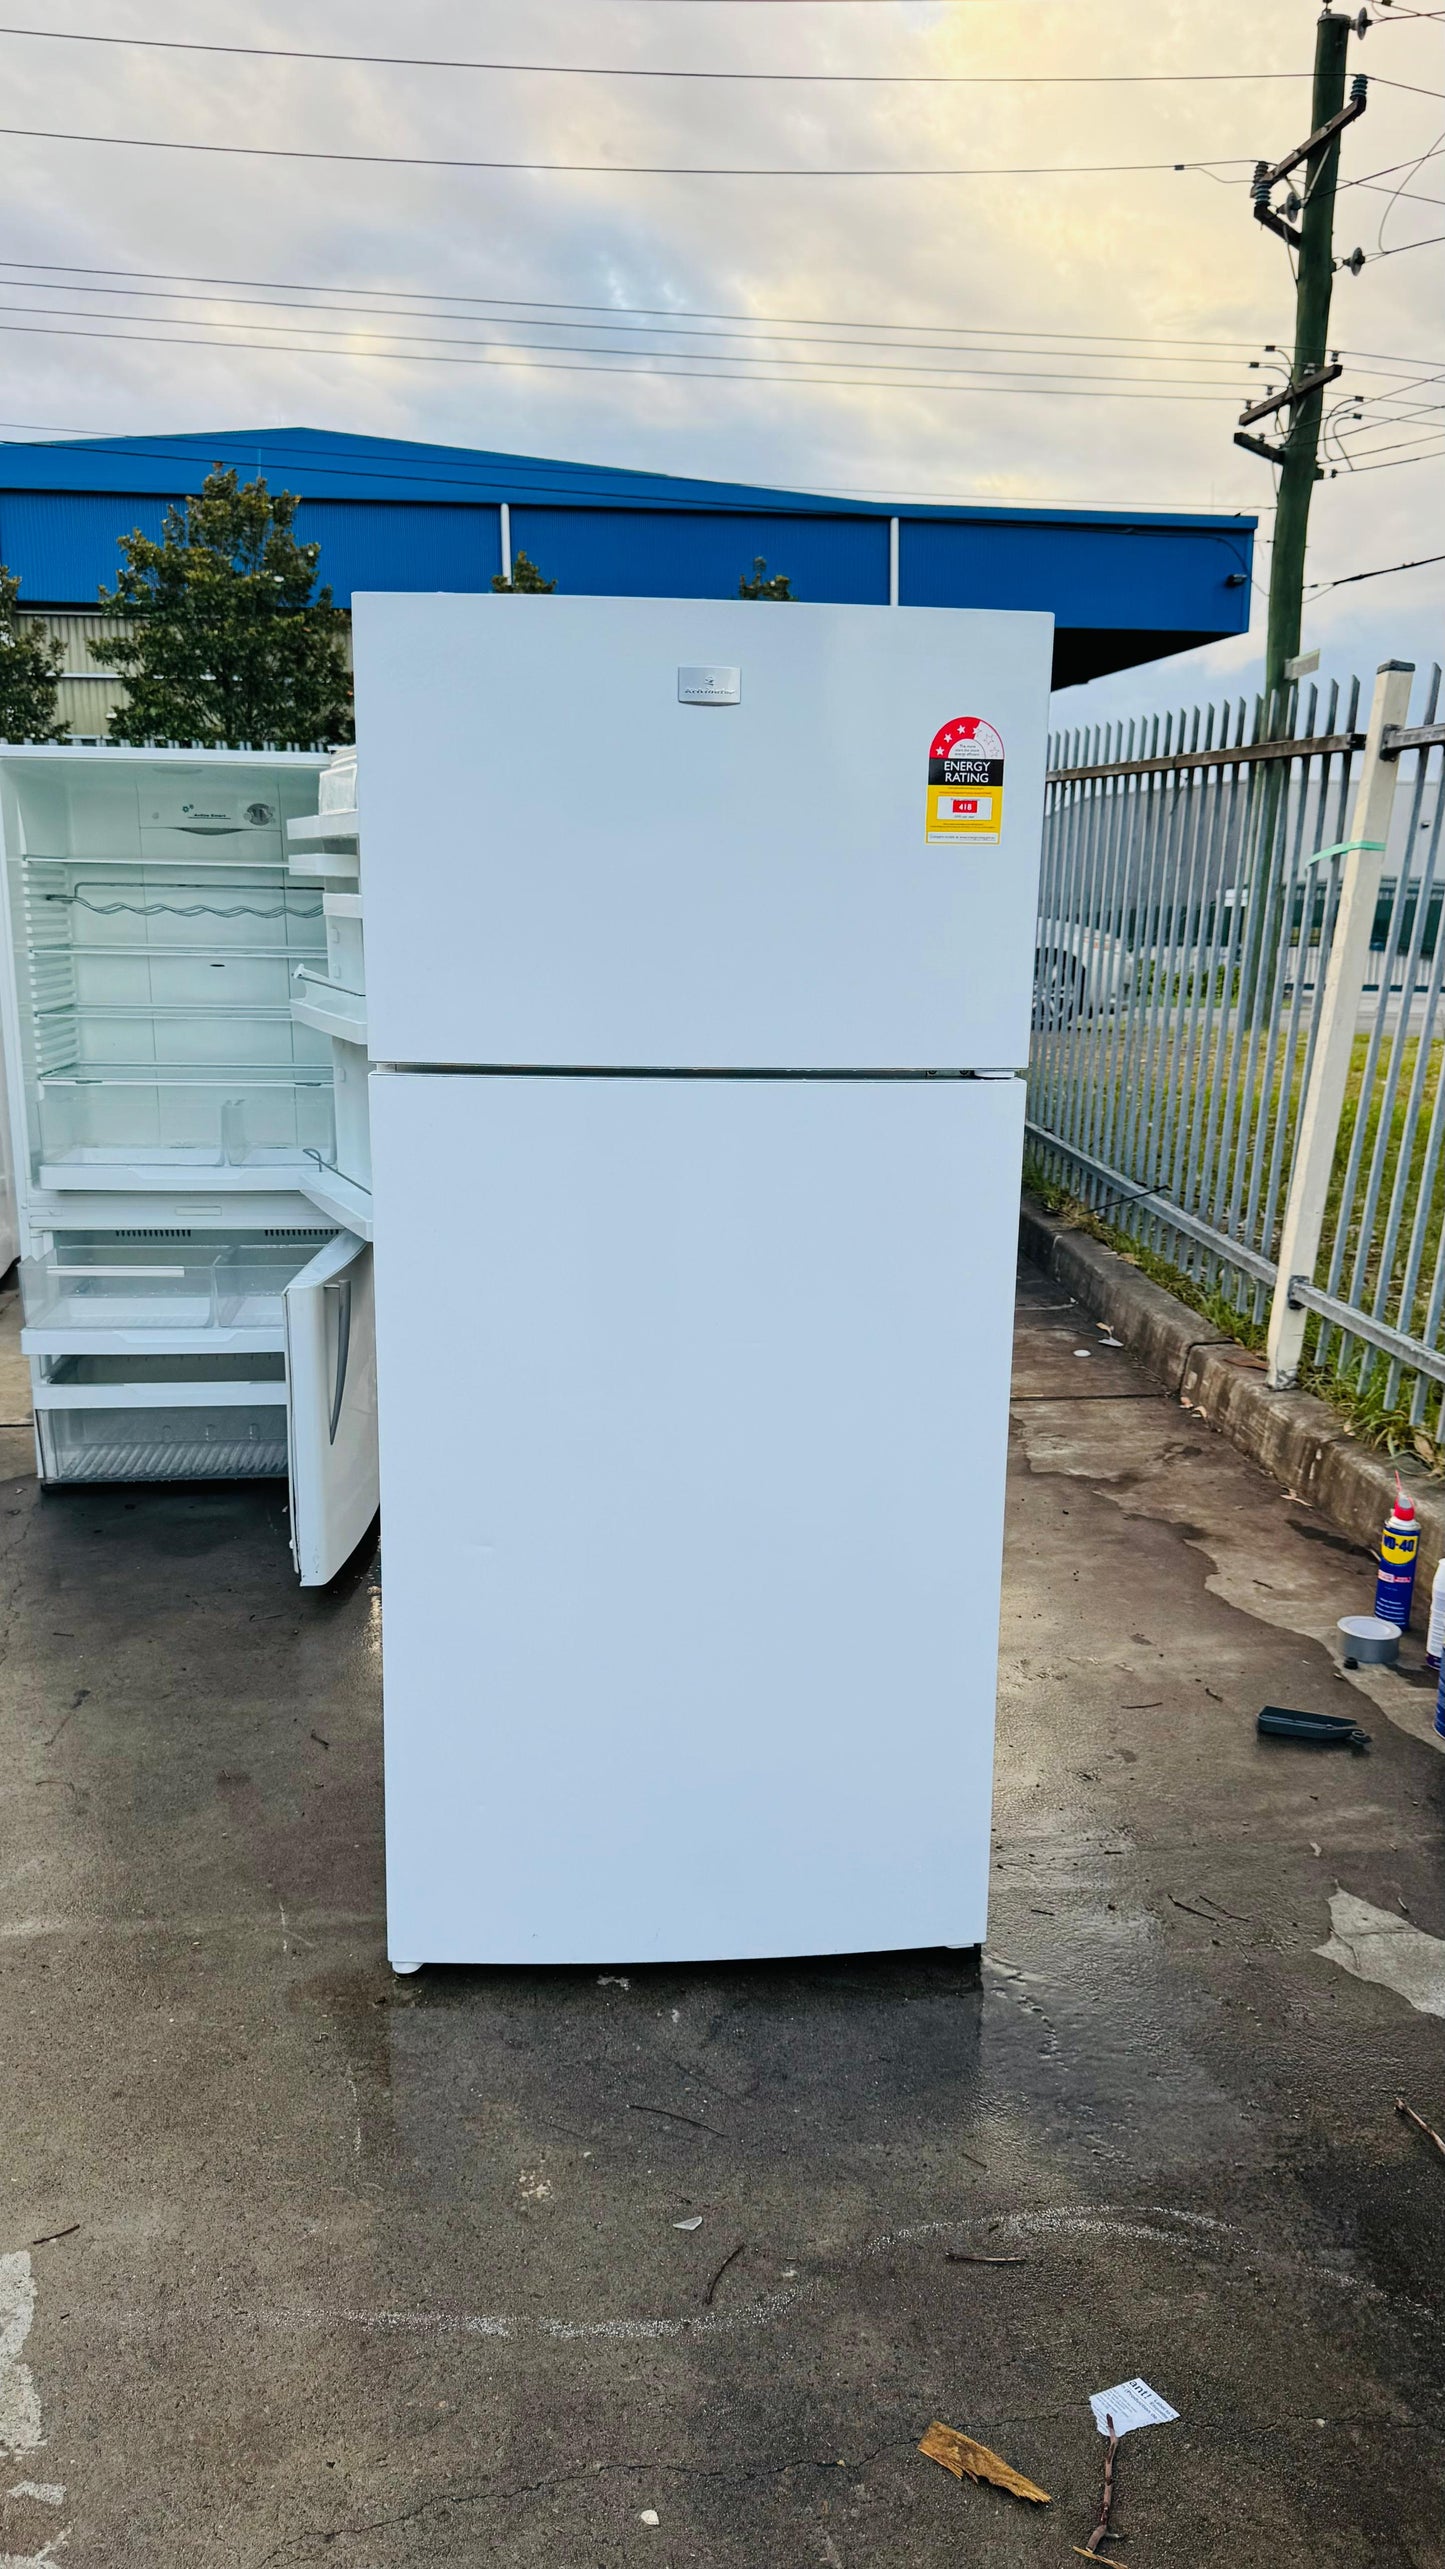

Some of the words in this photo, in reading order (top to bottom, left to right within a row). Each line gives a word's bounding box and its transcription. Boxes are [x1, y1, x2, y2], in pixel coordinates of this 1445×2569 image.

[944, 761, 991, 772] ENERGY
[945, 772, 989, 783] RATING
[958, 803, 973, 811] 418
[1383, 1535, 1415, 1552] WD-40
[1129, 2380, 1152, 2399] ant!
